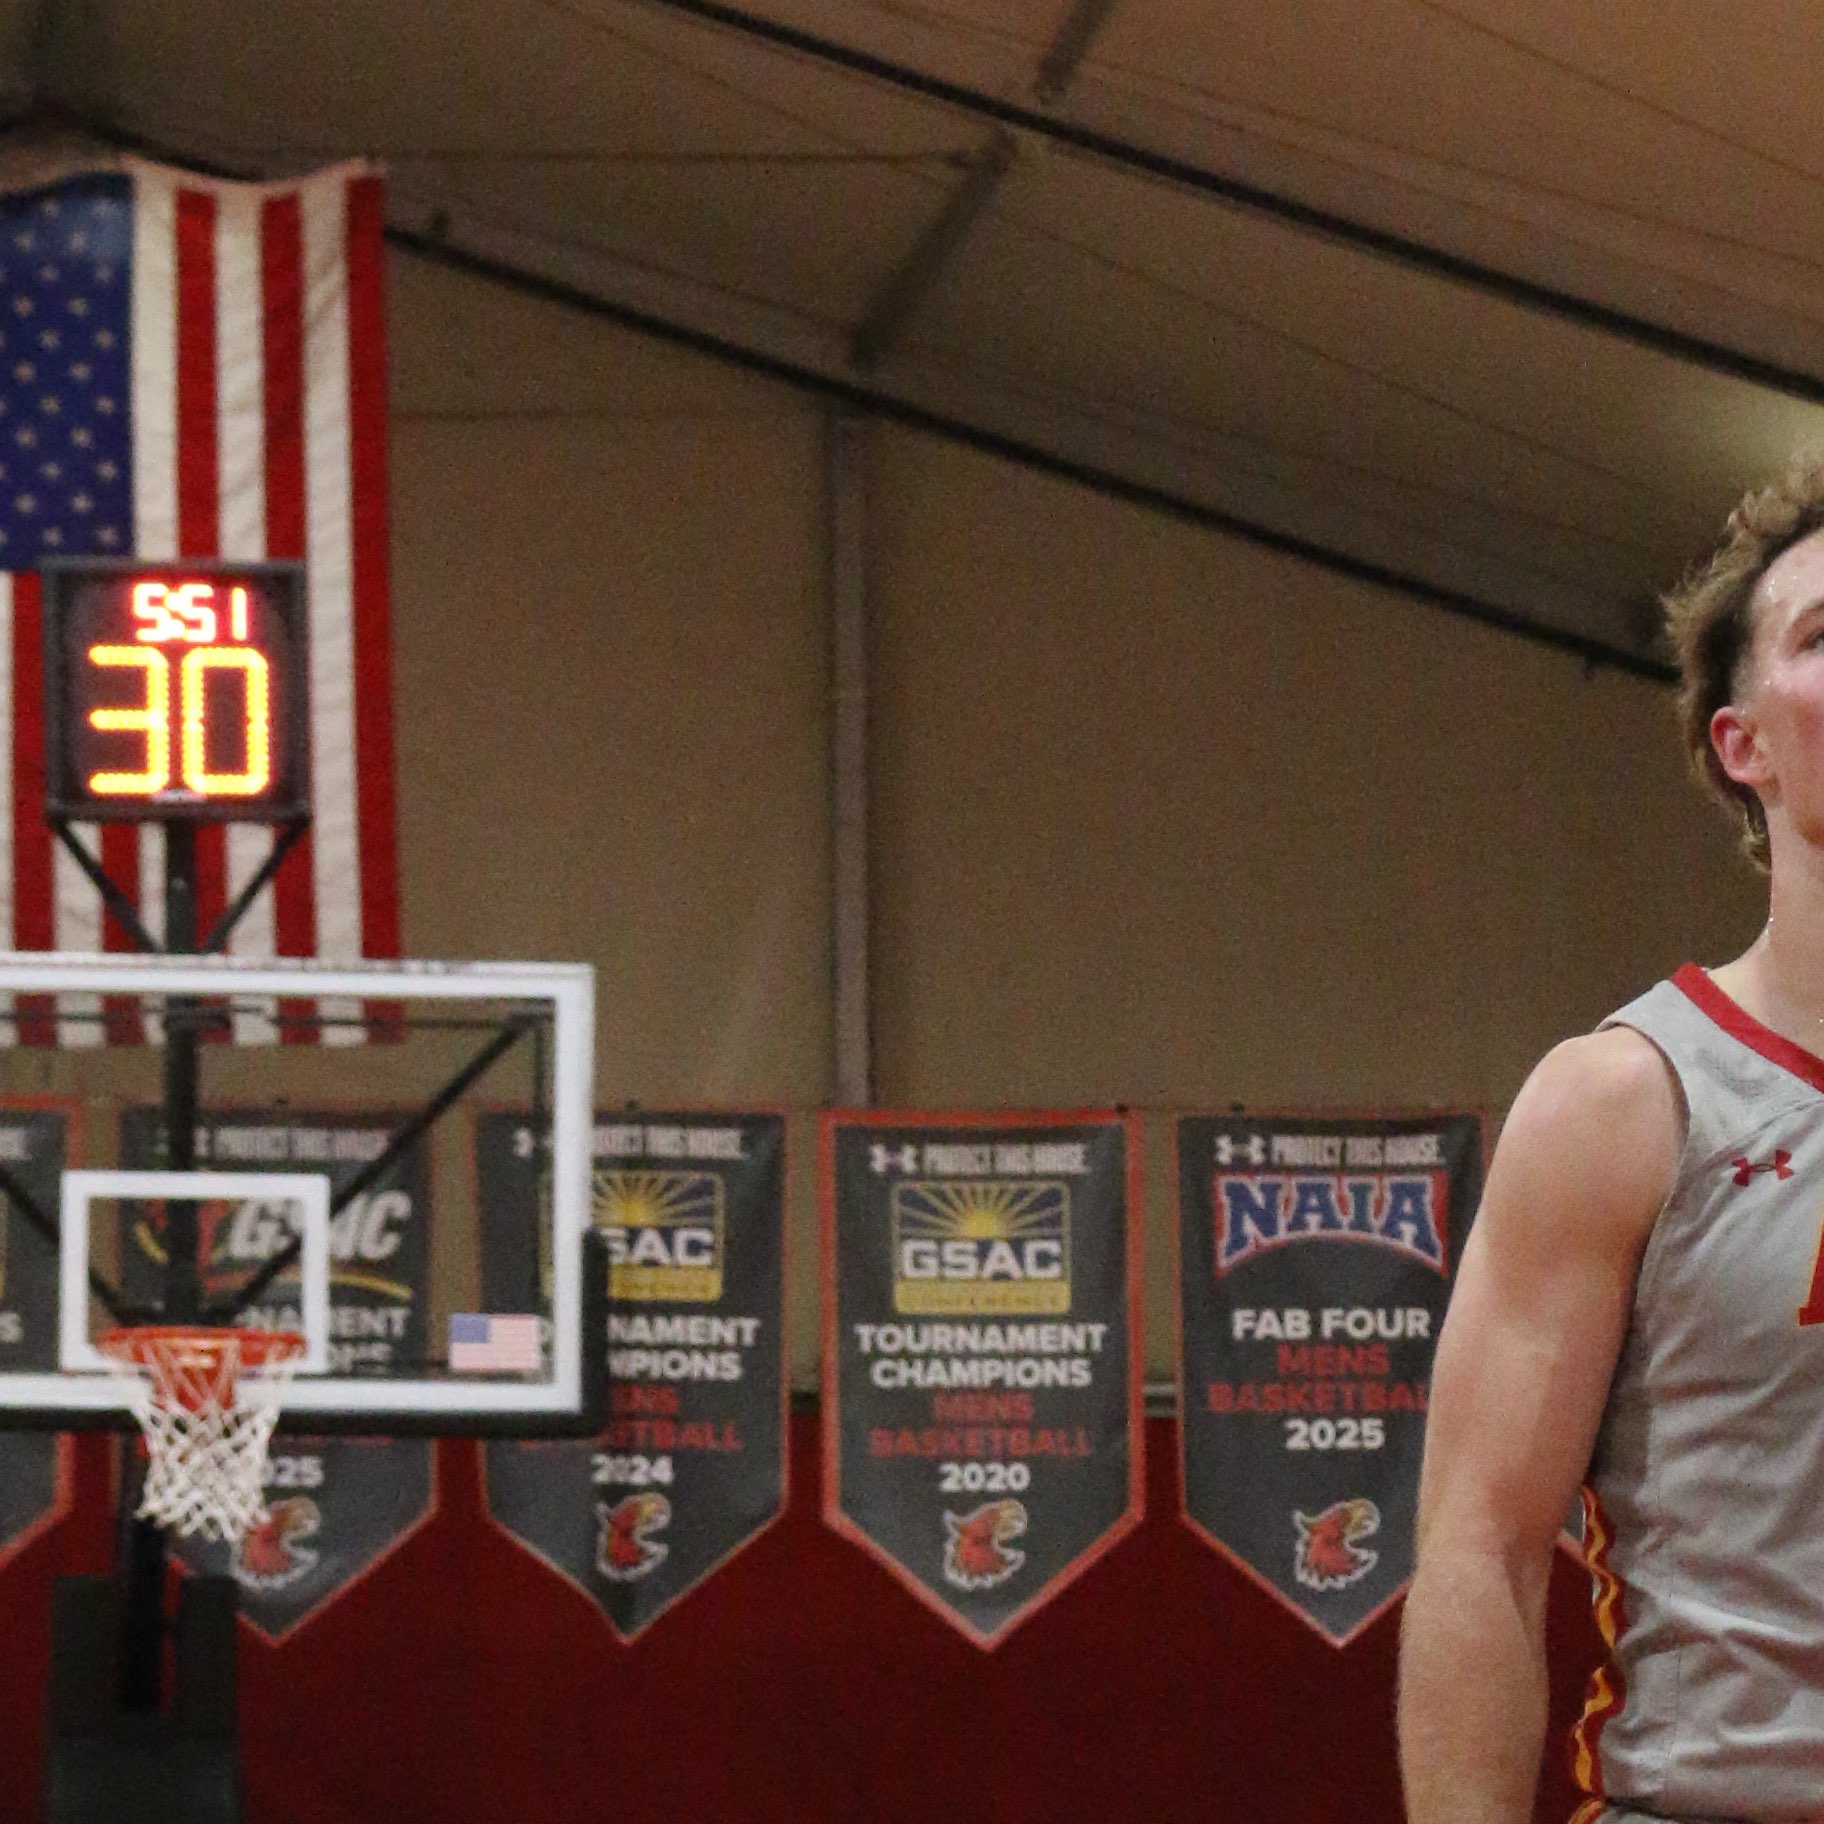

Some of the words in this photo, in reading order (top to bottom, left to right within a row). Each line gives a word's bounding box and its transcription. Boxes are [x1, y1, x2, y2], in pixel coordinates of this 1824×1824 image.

[87, 645, 268, 795] 30
[1216, 1173, 1444, 1268] NAIA
[902, 1239, 1063, 1279] GSAC
[606, 1315, 761, 1346] NAMENT
[854, 1323, 1107, 1354] TOURNAMENT
[1232, 1308, 1311, 1341] FAB
[1321, 1307, 1431, 1339] FOUR
[871, 1358, 1092, 1388] CHAMPIONS
[1276, 1343, 1390, 1375] MENS
[932, 1391, 1035, 1422] MENS
[1207, 1380, 1429, 1413] BASKETBAL
[870, 1427, 1093, 1457] BASKETBALL
[1285, 1418, 1386, 1450] 2025
[938, 1461, 1031, 1492] 2020
